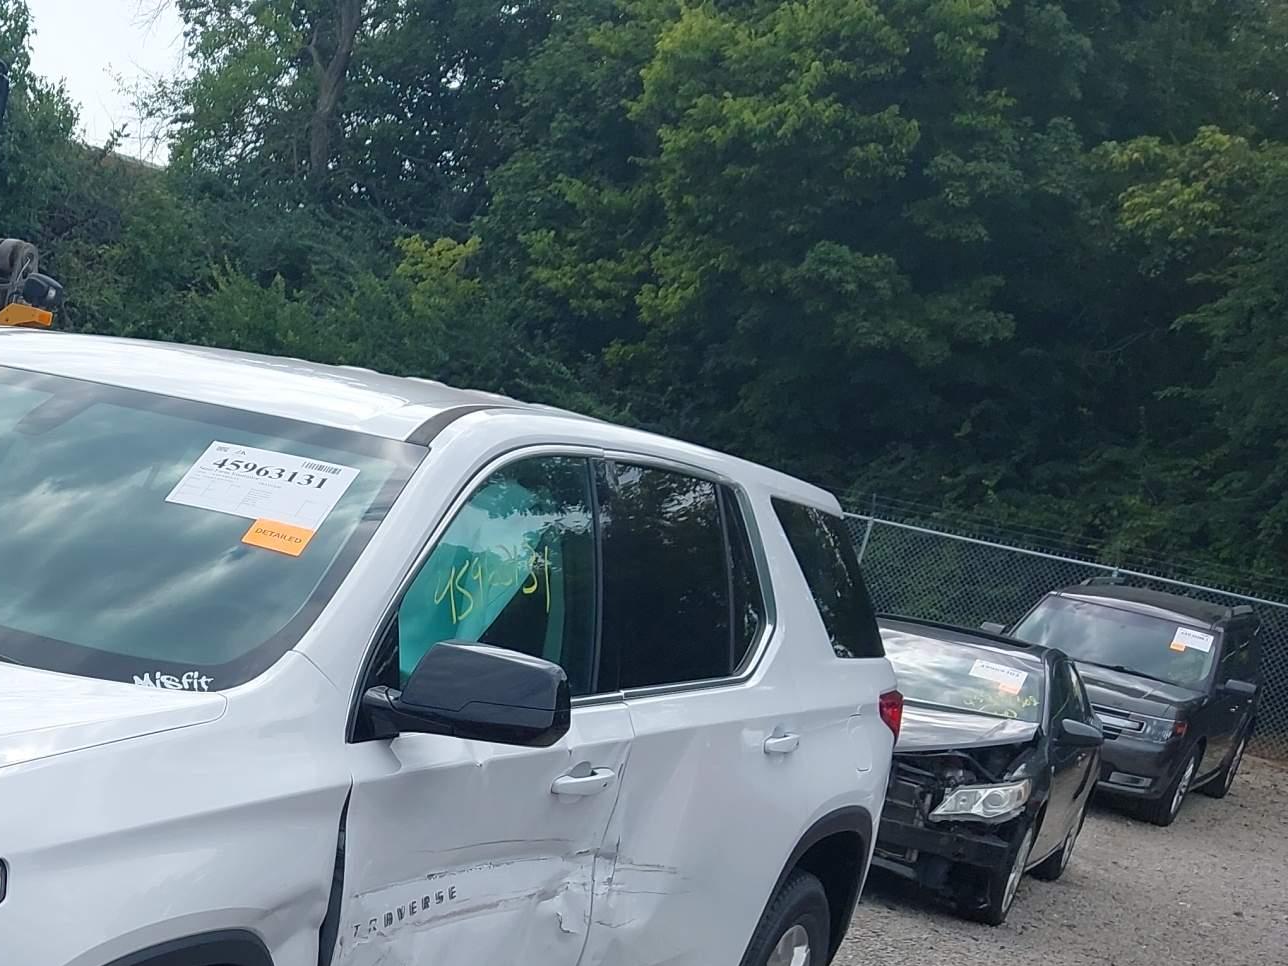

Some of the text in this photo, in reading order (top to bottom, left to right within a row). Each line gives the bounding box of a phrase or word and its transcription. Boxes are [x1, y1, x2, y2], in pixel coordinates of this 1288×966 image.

[213, 457, 329, 489] 45963131
[255, 527, 303, 544] DETAILED
[351, 885, 458, 938] TRAVERSE
